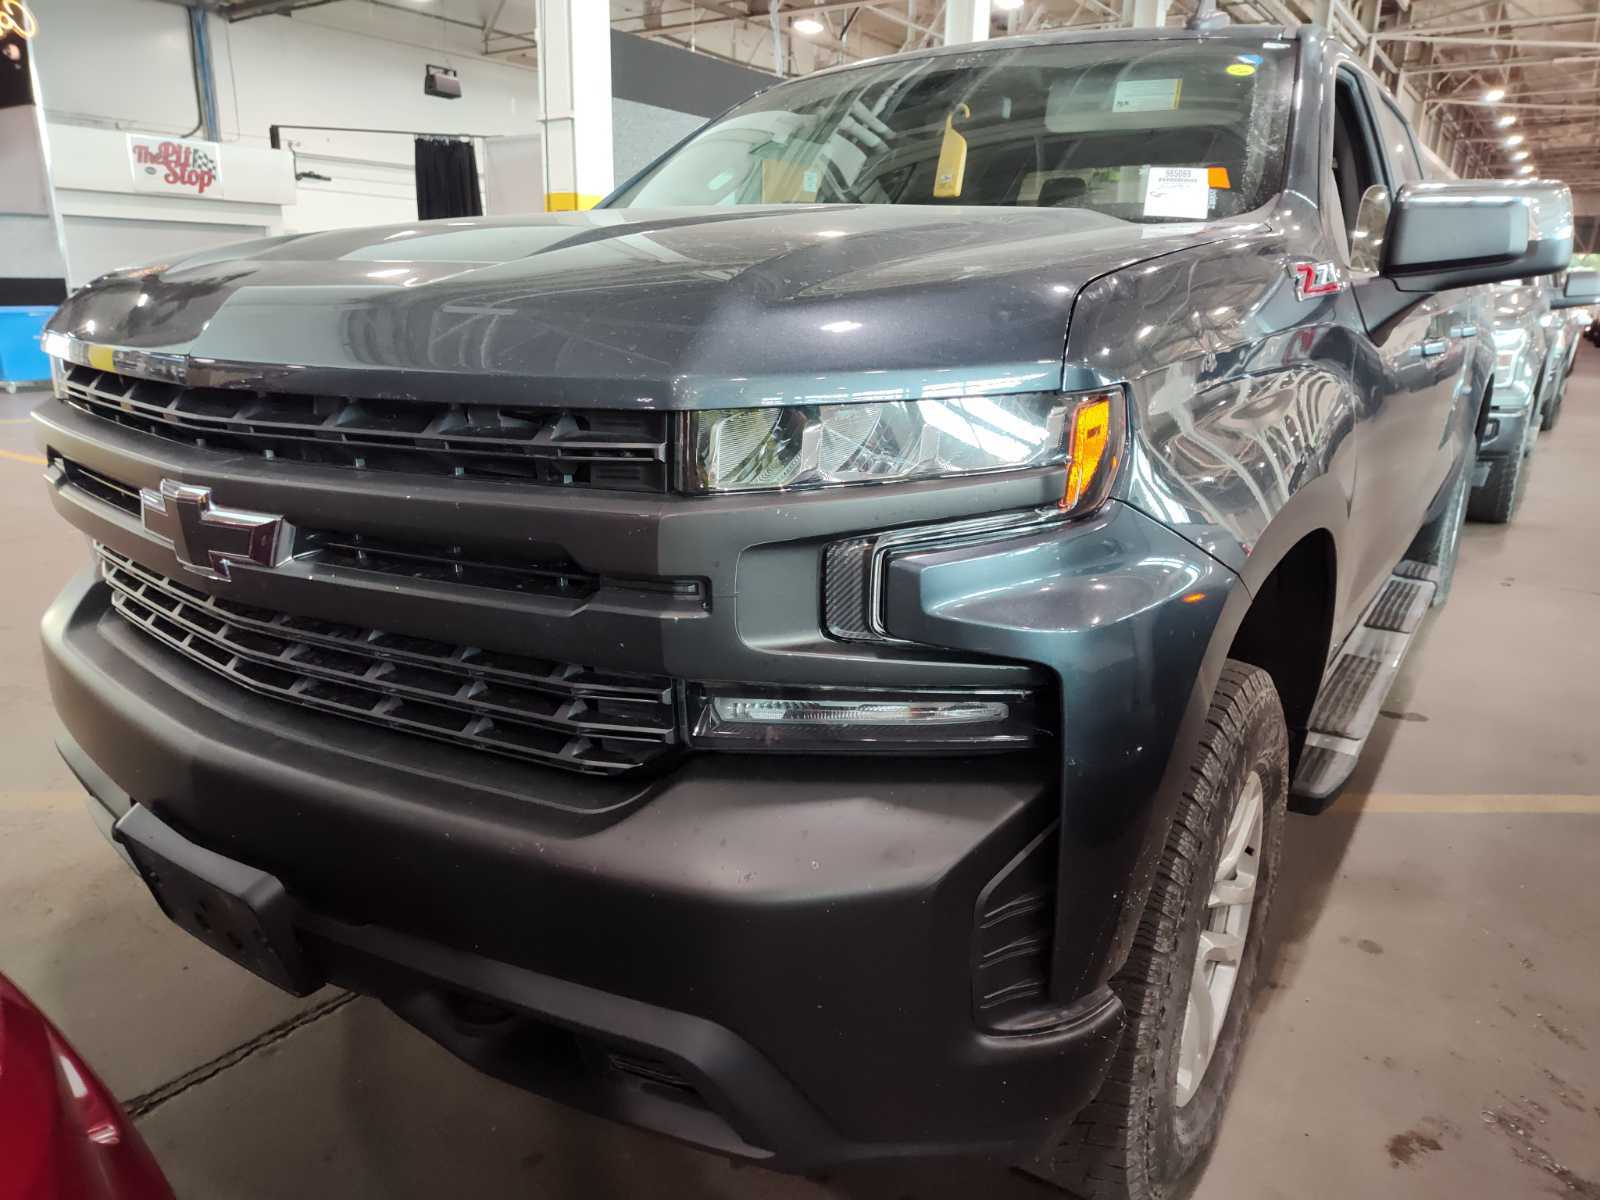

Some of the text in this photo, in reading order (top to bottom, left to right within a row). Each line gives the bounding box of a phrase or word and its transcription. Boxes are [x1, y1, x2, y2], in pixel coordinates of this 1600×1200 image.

[132, 141, 192, 168] The Pit
[163, 160, 213, 193] Stop
